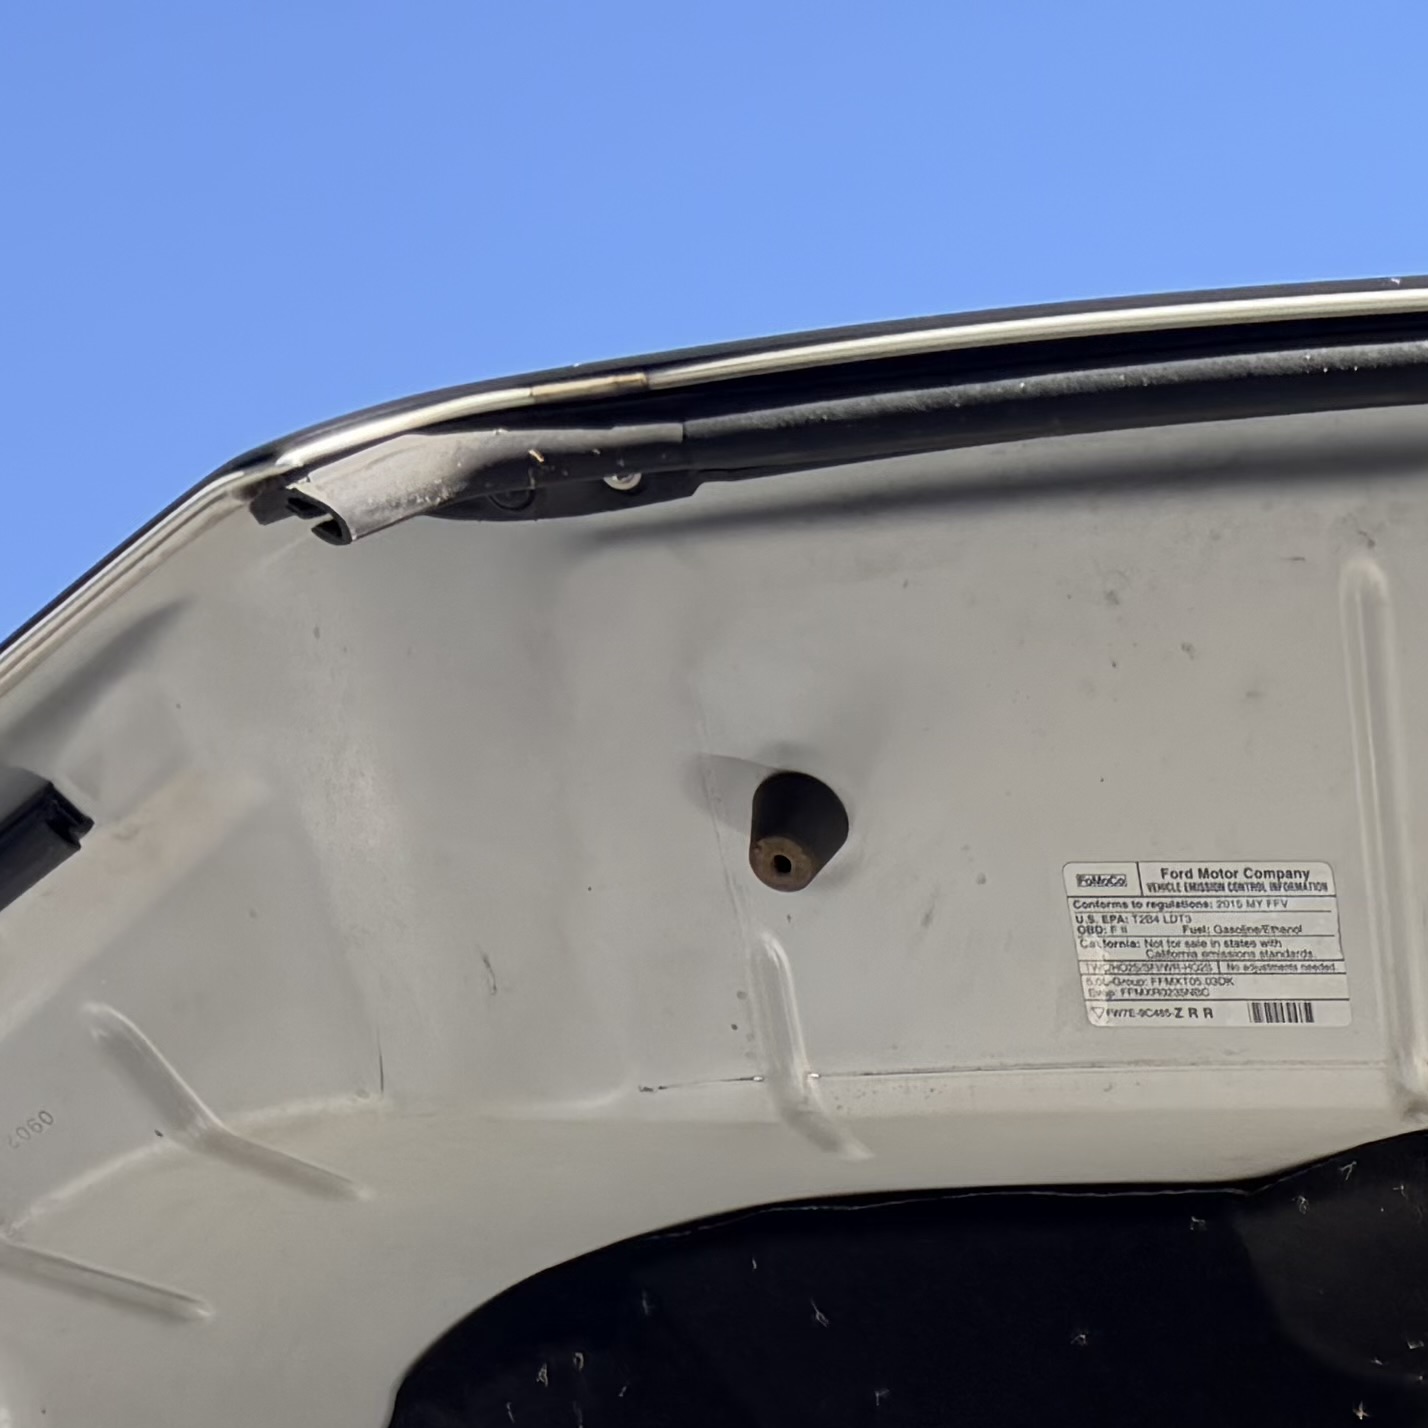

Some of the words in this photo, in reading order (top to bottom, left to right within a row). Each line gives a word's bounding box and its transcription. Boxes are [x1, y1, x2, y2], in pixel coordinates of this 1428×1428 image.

[1160, 868, 1194, 880] Ford
[1198, 868, 1239, 880] Motor
[1243, 867, 1311, 882] Company
[1146, 882, 1182, 893] VEHICLE
[1184, 882, 1226, 893] EMISSION
[1227, 882, 1267, 893] CONTROL
[1269, 881, 1328, 892] INFORMATION
[1073, 900, 1129, 910] Conforms
[1131, 900, 1144, 910] to
[1146, 900, 1214, 912] regulations:
[1246, 899, 1263, 909] MY
[1266, 899, 1289, 909] FFV
[1075, 914, 1099, 924] U.S.
[1101, 914, 1128, 924] EPA:
[1077, 925, 1108, 935] OBD:
[1182, 925, 1210, 935] Fuel:
[1080, 939, 1141, 949] Calfornia:
[1144, 939, 1164, 949] Not
[1167, 939, 1181, 949] for
[1210, 939, 1221, 949] in
[1224, 939, 1257, 949] states
[1260, 939, 1283, 949] with
